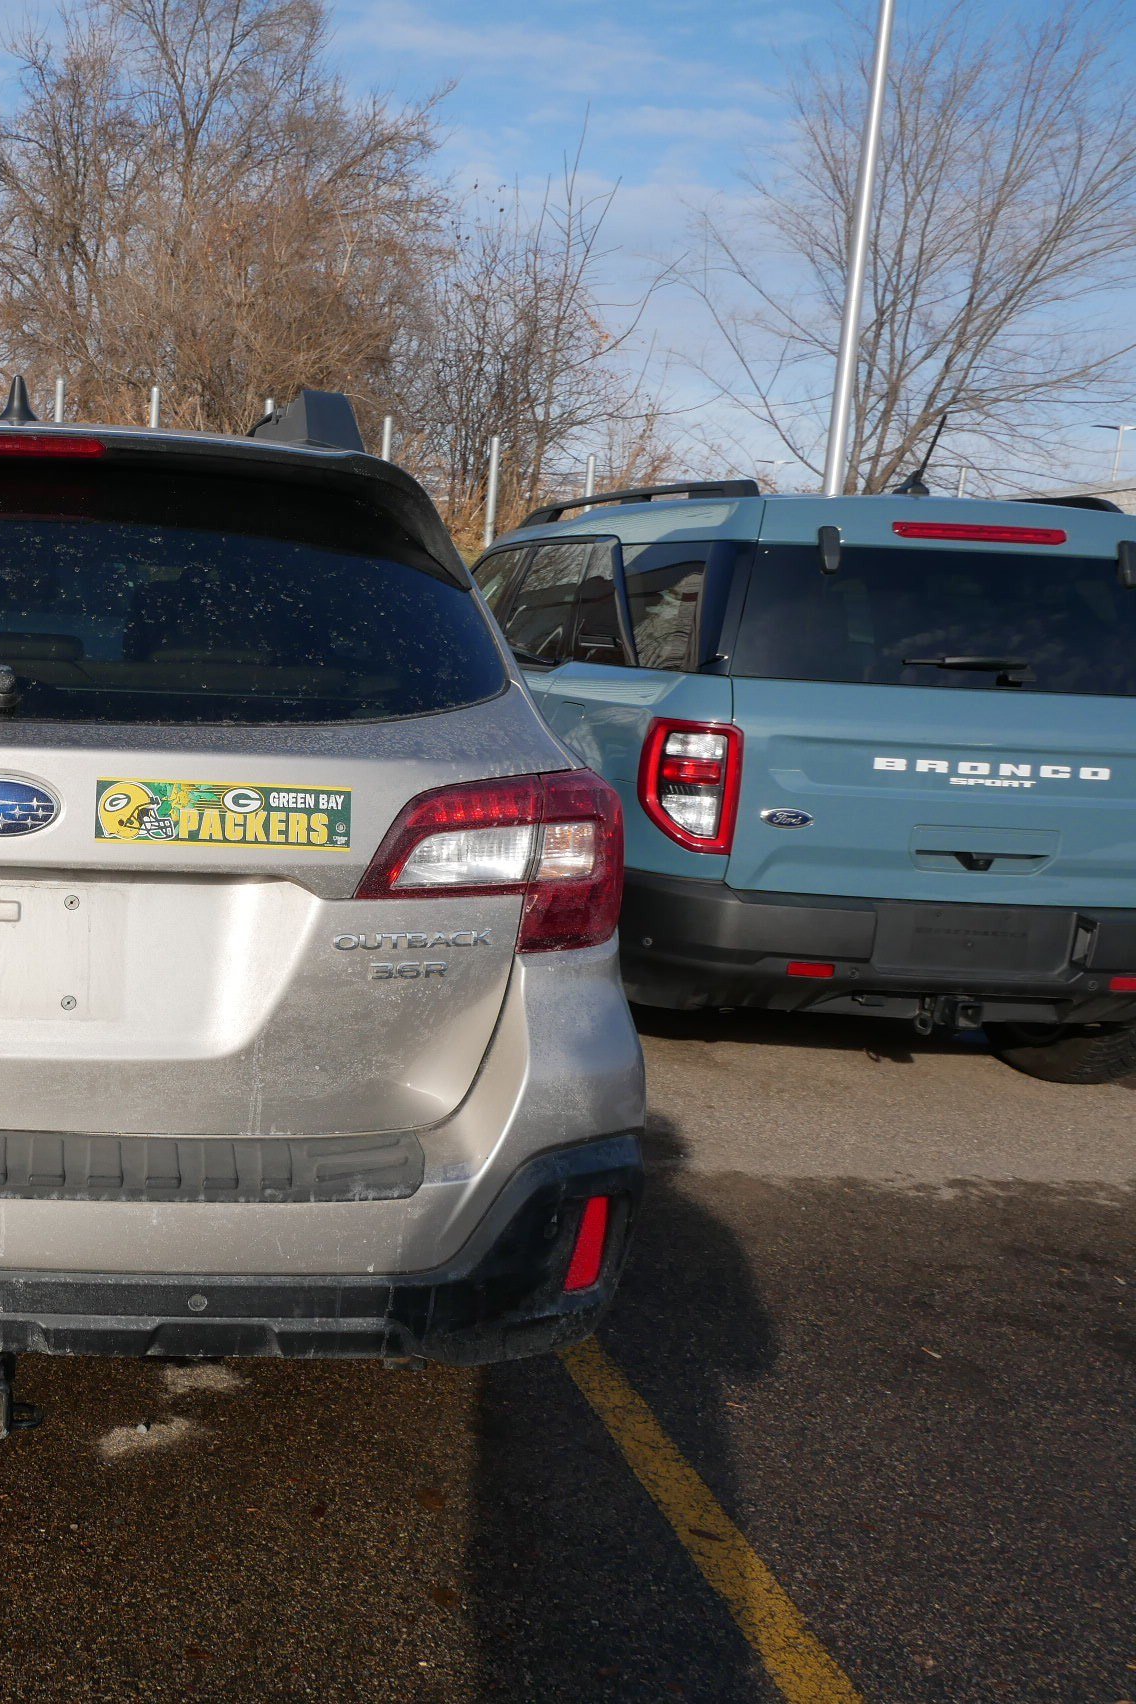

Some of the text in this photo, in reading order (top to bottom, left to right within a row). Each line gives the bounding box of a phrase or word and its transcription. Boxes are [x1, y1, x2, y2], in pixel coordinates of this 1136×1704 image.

[873, 757, 1111, 781] BRONCO
[949, 777, 1037, 788] SPORT
[269, 791, 345, 810] GREEN BAY
[178, 808, 329, 845] PACKERS
[333, 929, 494, 951] OUTBACK
